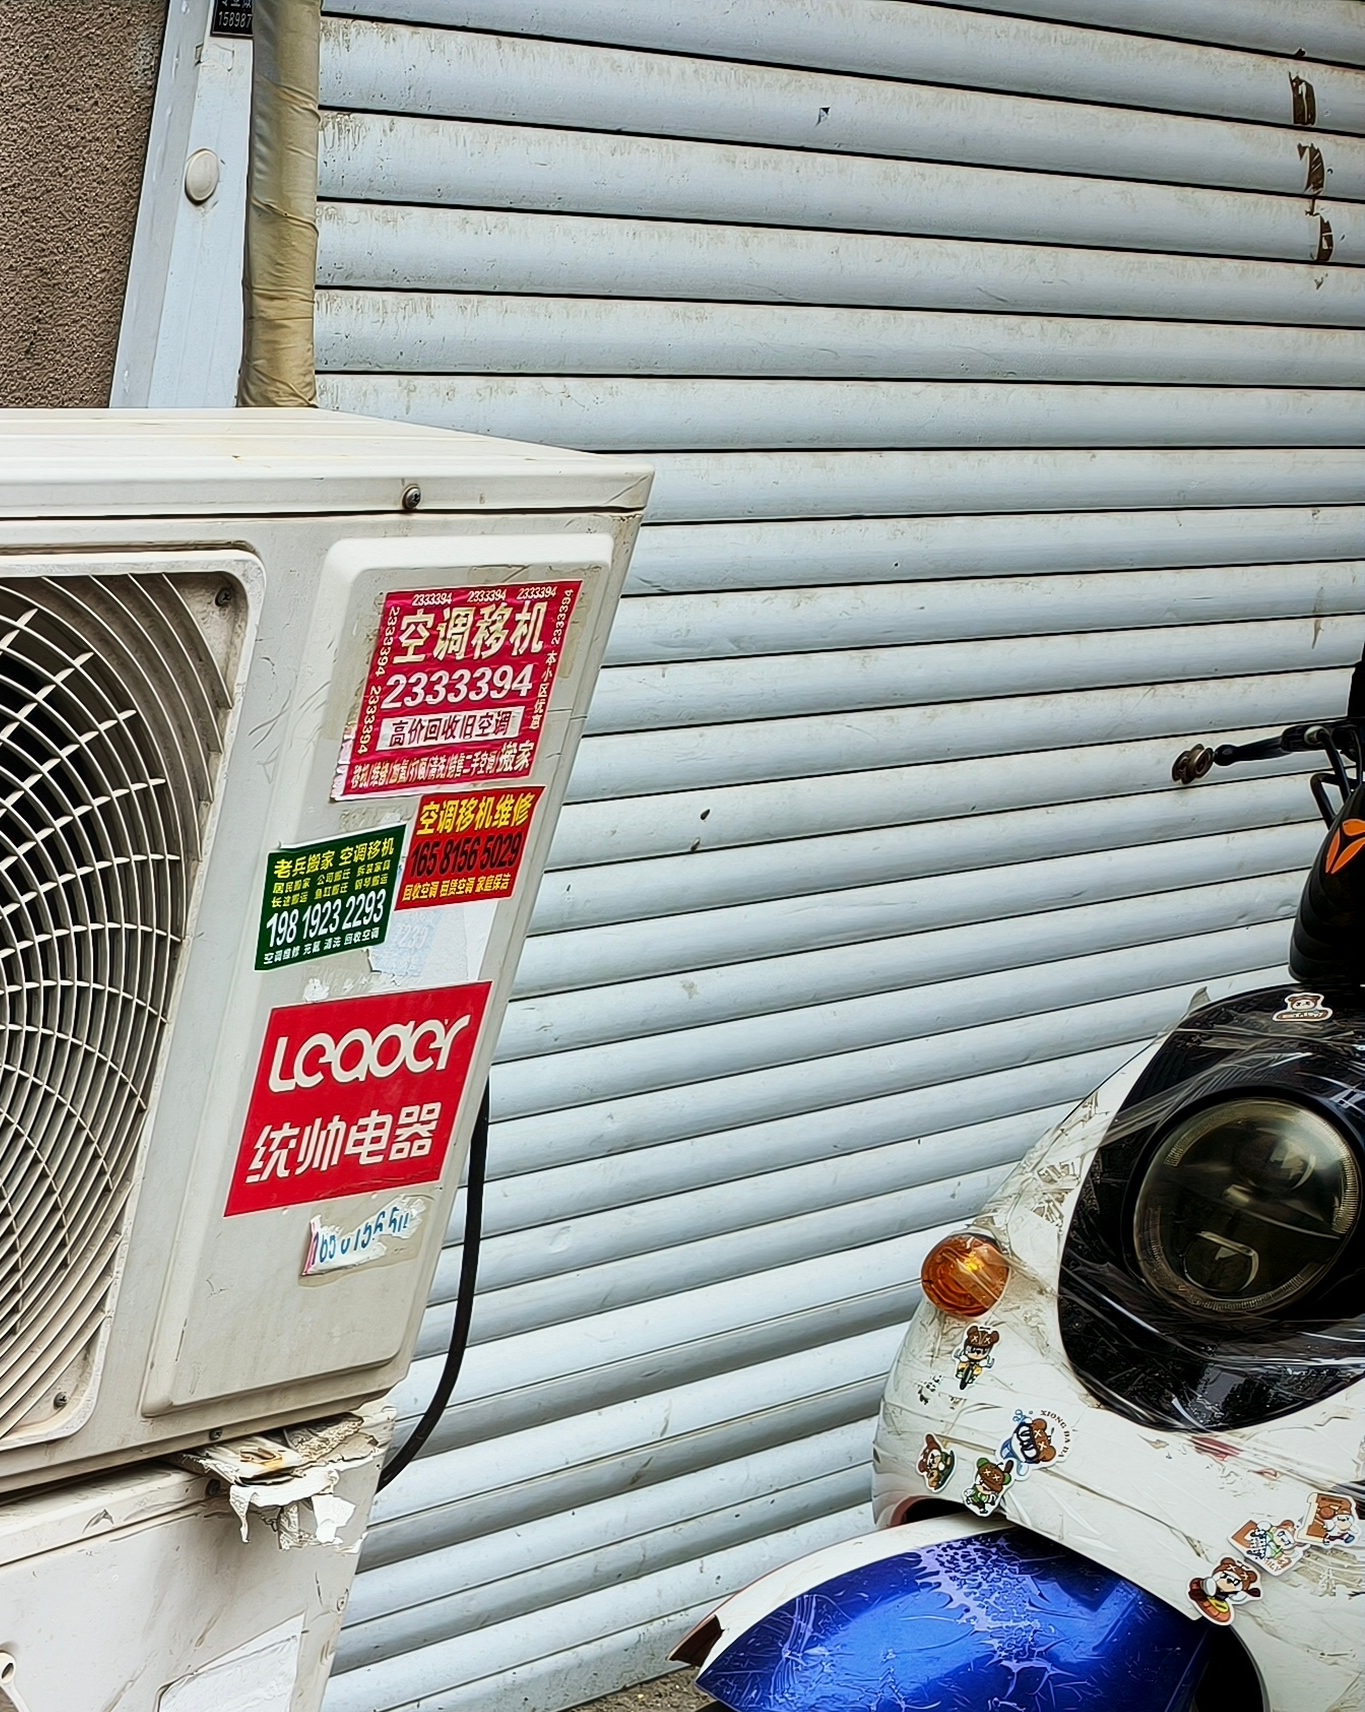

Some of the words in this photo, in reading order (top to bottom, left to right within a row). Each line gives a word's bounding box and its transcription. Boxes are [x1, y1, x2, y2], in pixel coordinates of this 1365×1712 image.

[412, 591, 453, 607] 2333394
[467, 588, 508, 603] 2333394
[517, 585, 557, 600] 2333394
[551, 589, 574, 646] 2333394
[375, 605, 400, 677] 2333394
[392, 599, 547, 665] 空调移机
[380, 663, 533, 710] 2333394
[357, 685, 381, 755] 2333394
[389, 711, 512, 747] 高价回收旧空调
[416, 792, 536, 836] 空调移机维修
[273, 850, 336, 879] 老兵搬家
[338, 837, 395, 867] 空调移机
[410, 840, 442, 878] 165
[439, 836, 482, 875] 8156
[479, 832, 523, 871] 5029
[401, 880, 440, 902] 回收空调
[266, 908, 300, 948] 198
[302, 898, 342, 940] 1923
[341, 888, 387, 930] 2293
[269, 1014, 471, 1094] Leader
[245, 1101, 442, 1184] 统帅电器
[1040, 1409, 1067, 1429] XIONG
